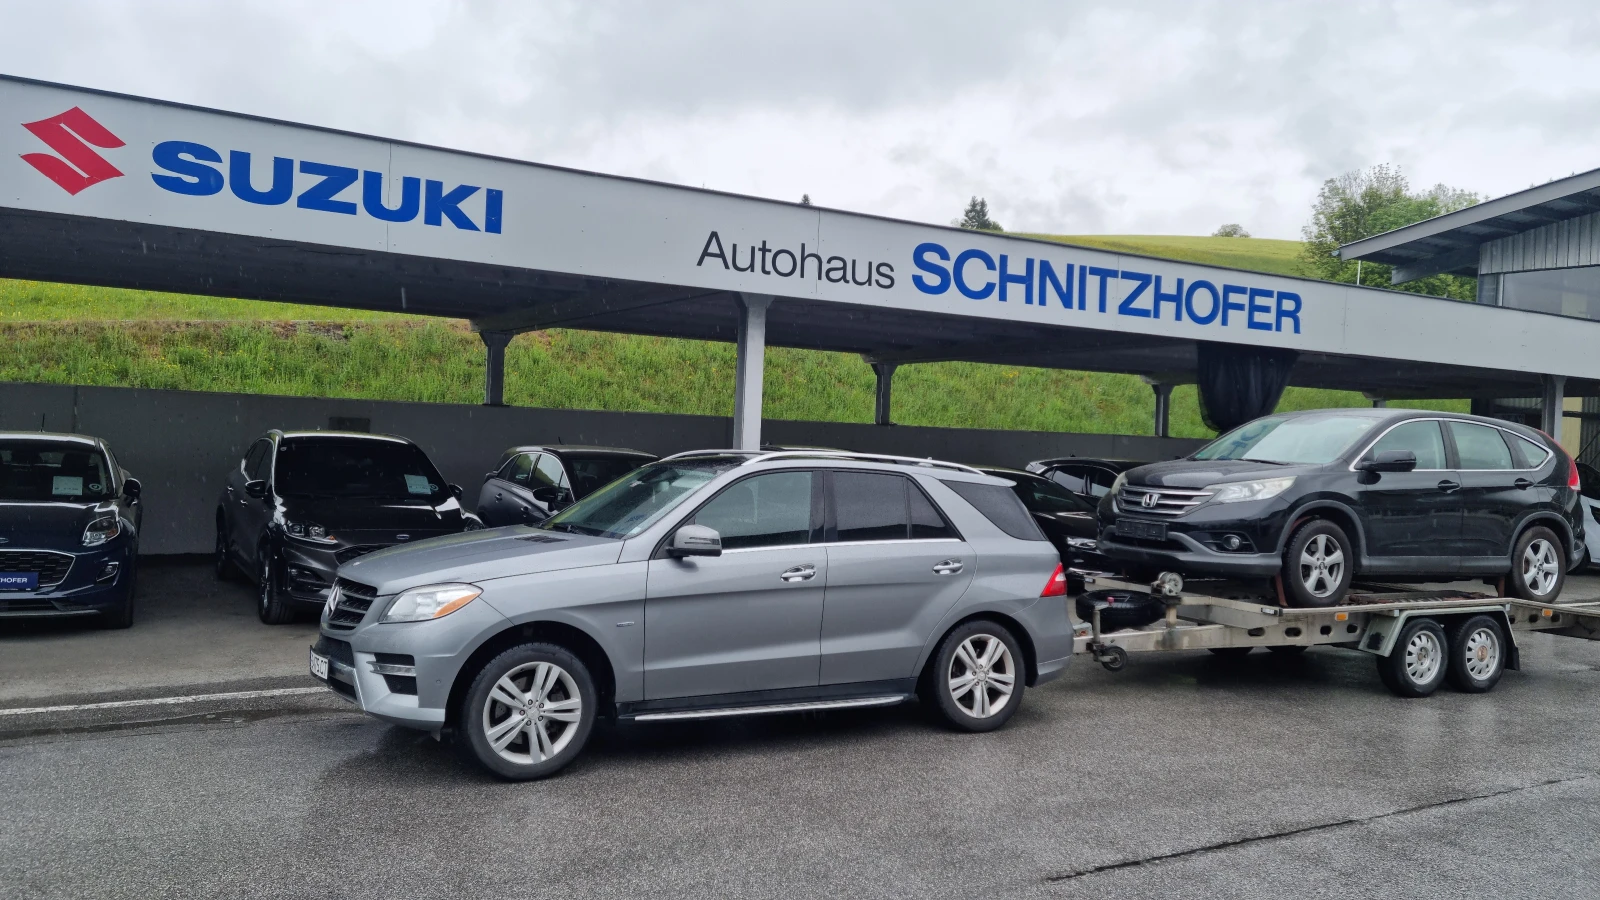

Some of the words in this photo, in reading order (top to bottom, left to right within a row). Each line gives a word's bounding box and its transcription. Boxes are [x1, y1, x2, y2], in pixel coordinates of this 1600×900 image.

[151, 140, 503, 235] SUZUKI
[697, 231, 895, 289] Autohaus
[911, 242, 1302, 334] SCHNITZHOFER
